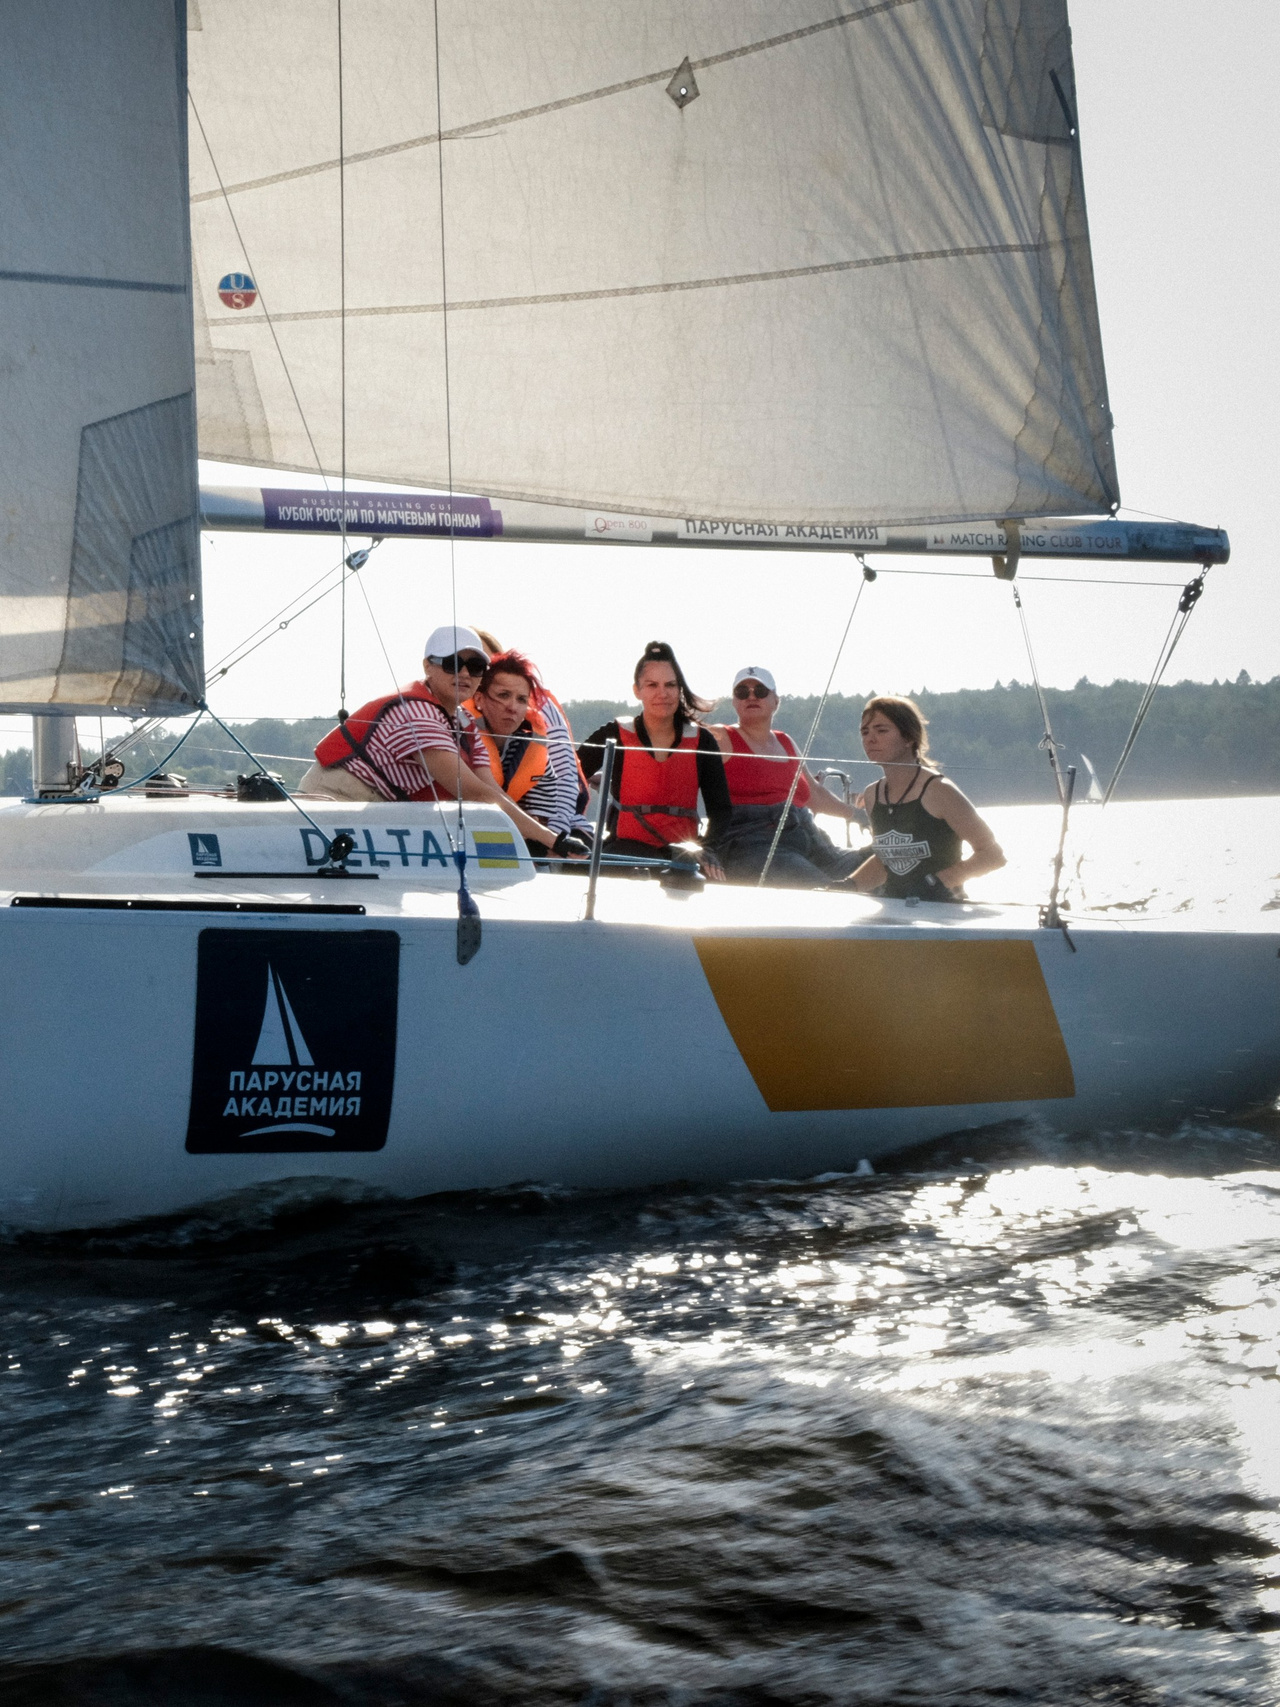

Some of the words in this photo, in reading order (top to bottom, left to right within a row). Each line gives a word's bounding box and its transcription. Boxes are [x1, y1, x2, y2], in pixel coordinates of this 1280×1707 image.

[368, 501, 422, 510] SAILING
[278, 506, 314, 522] КУБОК
[316, 508, 358, 524] РОССИИ
[361, 509, 375, 524] ПО
[377, 510, 437, 526] МАТЧЕВЫМ
[439, 512, 481, 529] ГОНКАМ
[628, 520, 648, 530] 800
[685, 519, 779, 537] ПАРУСНАЯ
[785, 525, 880, 541] АКАДЕМИЯ
[950, 533, 994, 546] MATCH
[997, 534, 1047, 548] RING
[1050, 534, 1083, 549] CLUB
[1087, 536, 1123, 550] TOUR
[299, 828, 449, 868] DELTA
[229, 1070, 362, 1092] ПАРУСНАЯ
[222, 1096, 361, 1119] АКАДЕМИЯ
